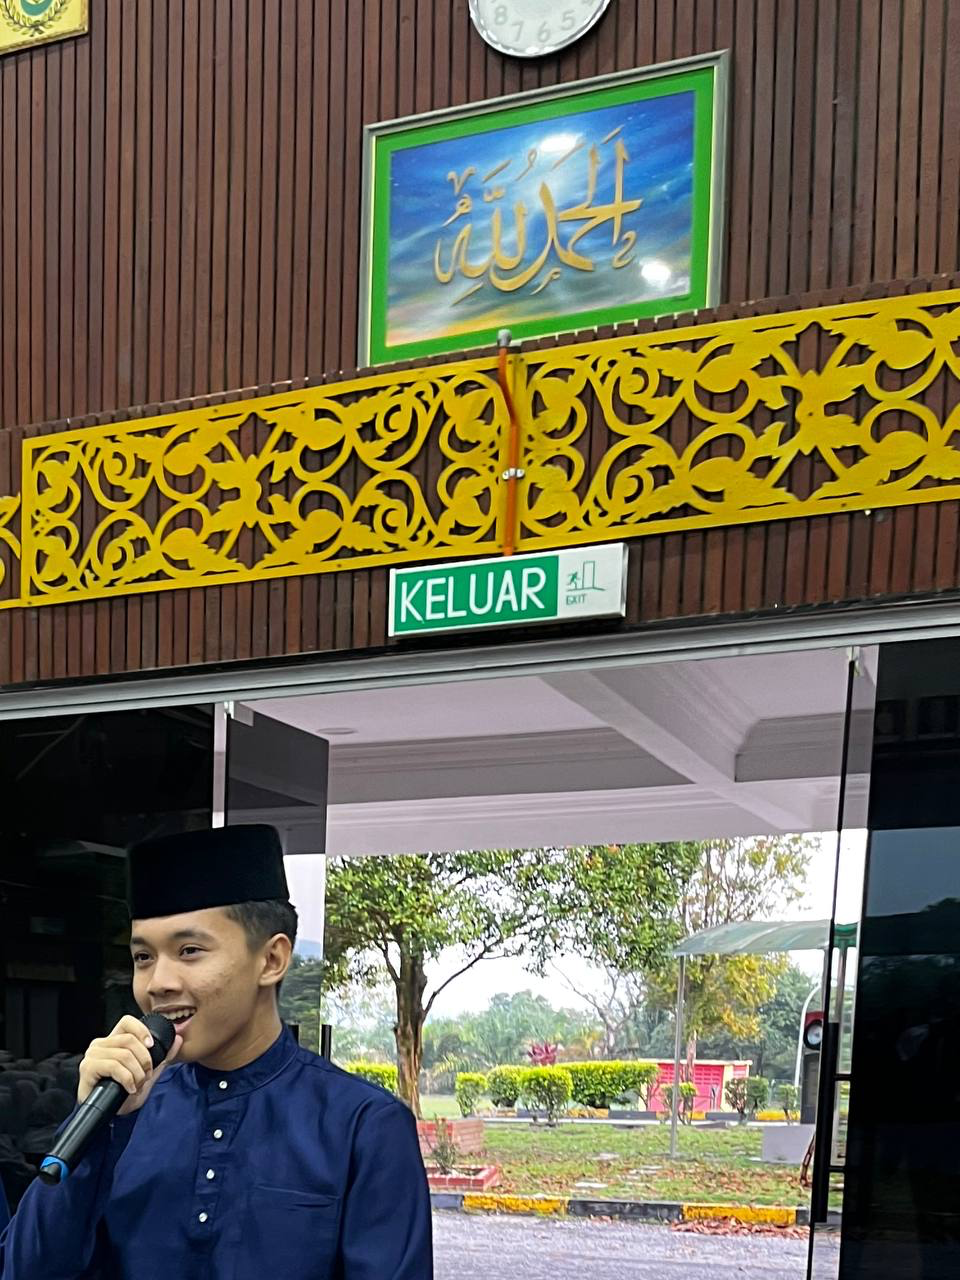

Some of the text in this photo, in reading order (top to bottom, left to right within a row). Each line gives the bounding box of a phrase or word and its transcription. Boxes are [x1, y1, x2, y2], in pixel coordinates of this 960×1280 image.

[494, 5, 508, 26] 8
[560, 10, 575, 30] 5
[511, 21, 524, 42] 7
[537, 22, 551, 43] 6
[401, 567, 547, 624] KELUAR
[566, 594, 587, 606] EXIT
